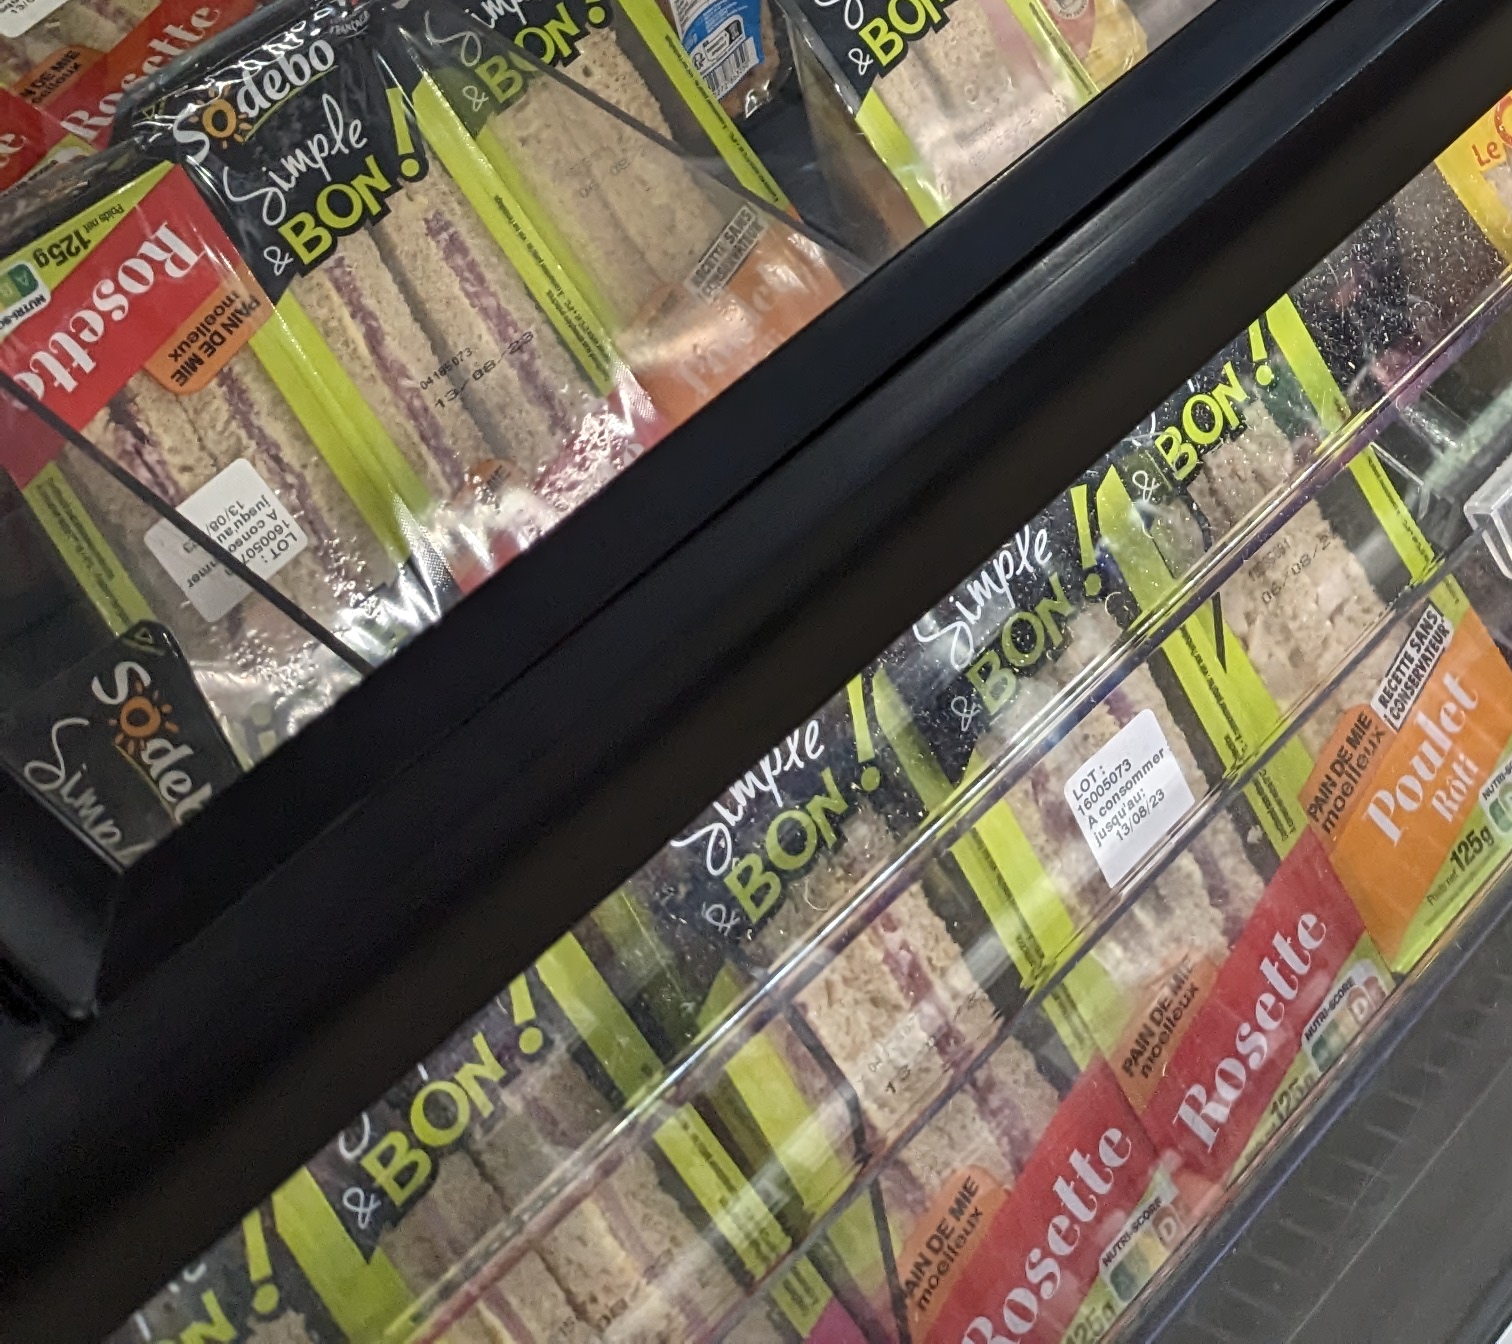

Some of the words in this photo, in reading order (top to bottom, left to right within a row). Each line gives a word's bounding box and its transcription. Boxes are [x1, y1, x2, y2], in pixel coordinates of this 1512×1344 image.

[173, 37, 336, 164] Sodebo
[223, 93, 368, 224] Simple
[1471, 142, 1500, 168] Le
[33, 227, 92, 269] 125g
[221, 295, 263, 334] PAIN
[170, 355, 202, 388] MIE
[911, 525, 1055, 670] Simple
[1377, 650, 1418, 711] RECETTE
[1389, 621, 1453, 724] CONSERVATEUR
[1074, 756, 1134, 818] 16005073
[1098, 746, 1168, 820] consommer
[1305, 777, 1347, 823] PAIN
[1348, 708, 1376, 749] MIE
[1321, 724, 1387, 836] moelleux
[1361, 672, 1482, 847] Poulet
[1429, 750, 1483, 826] Rôti
[669, 719, 827, 878] Simple
[1114, 788, 1168, 844] 13/08/23
[1448, 823, 1498, 873] 125g
[1170, 908, 1330, 1155] Rosette
